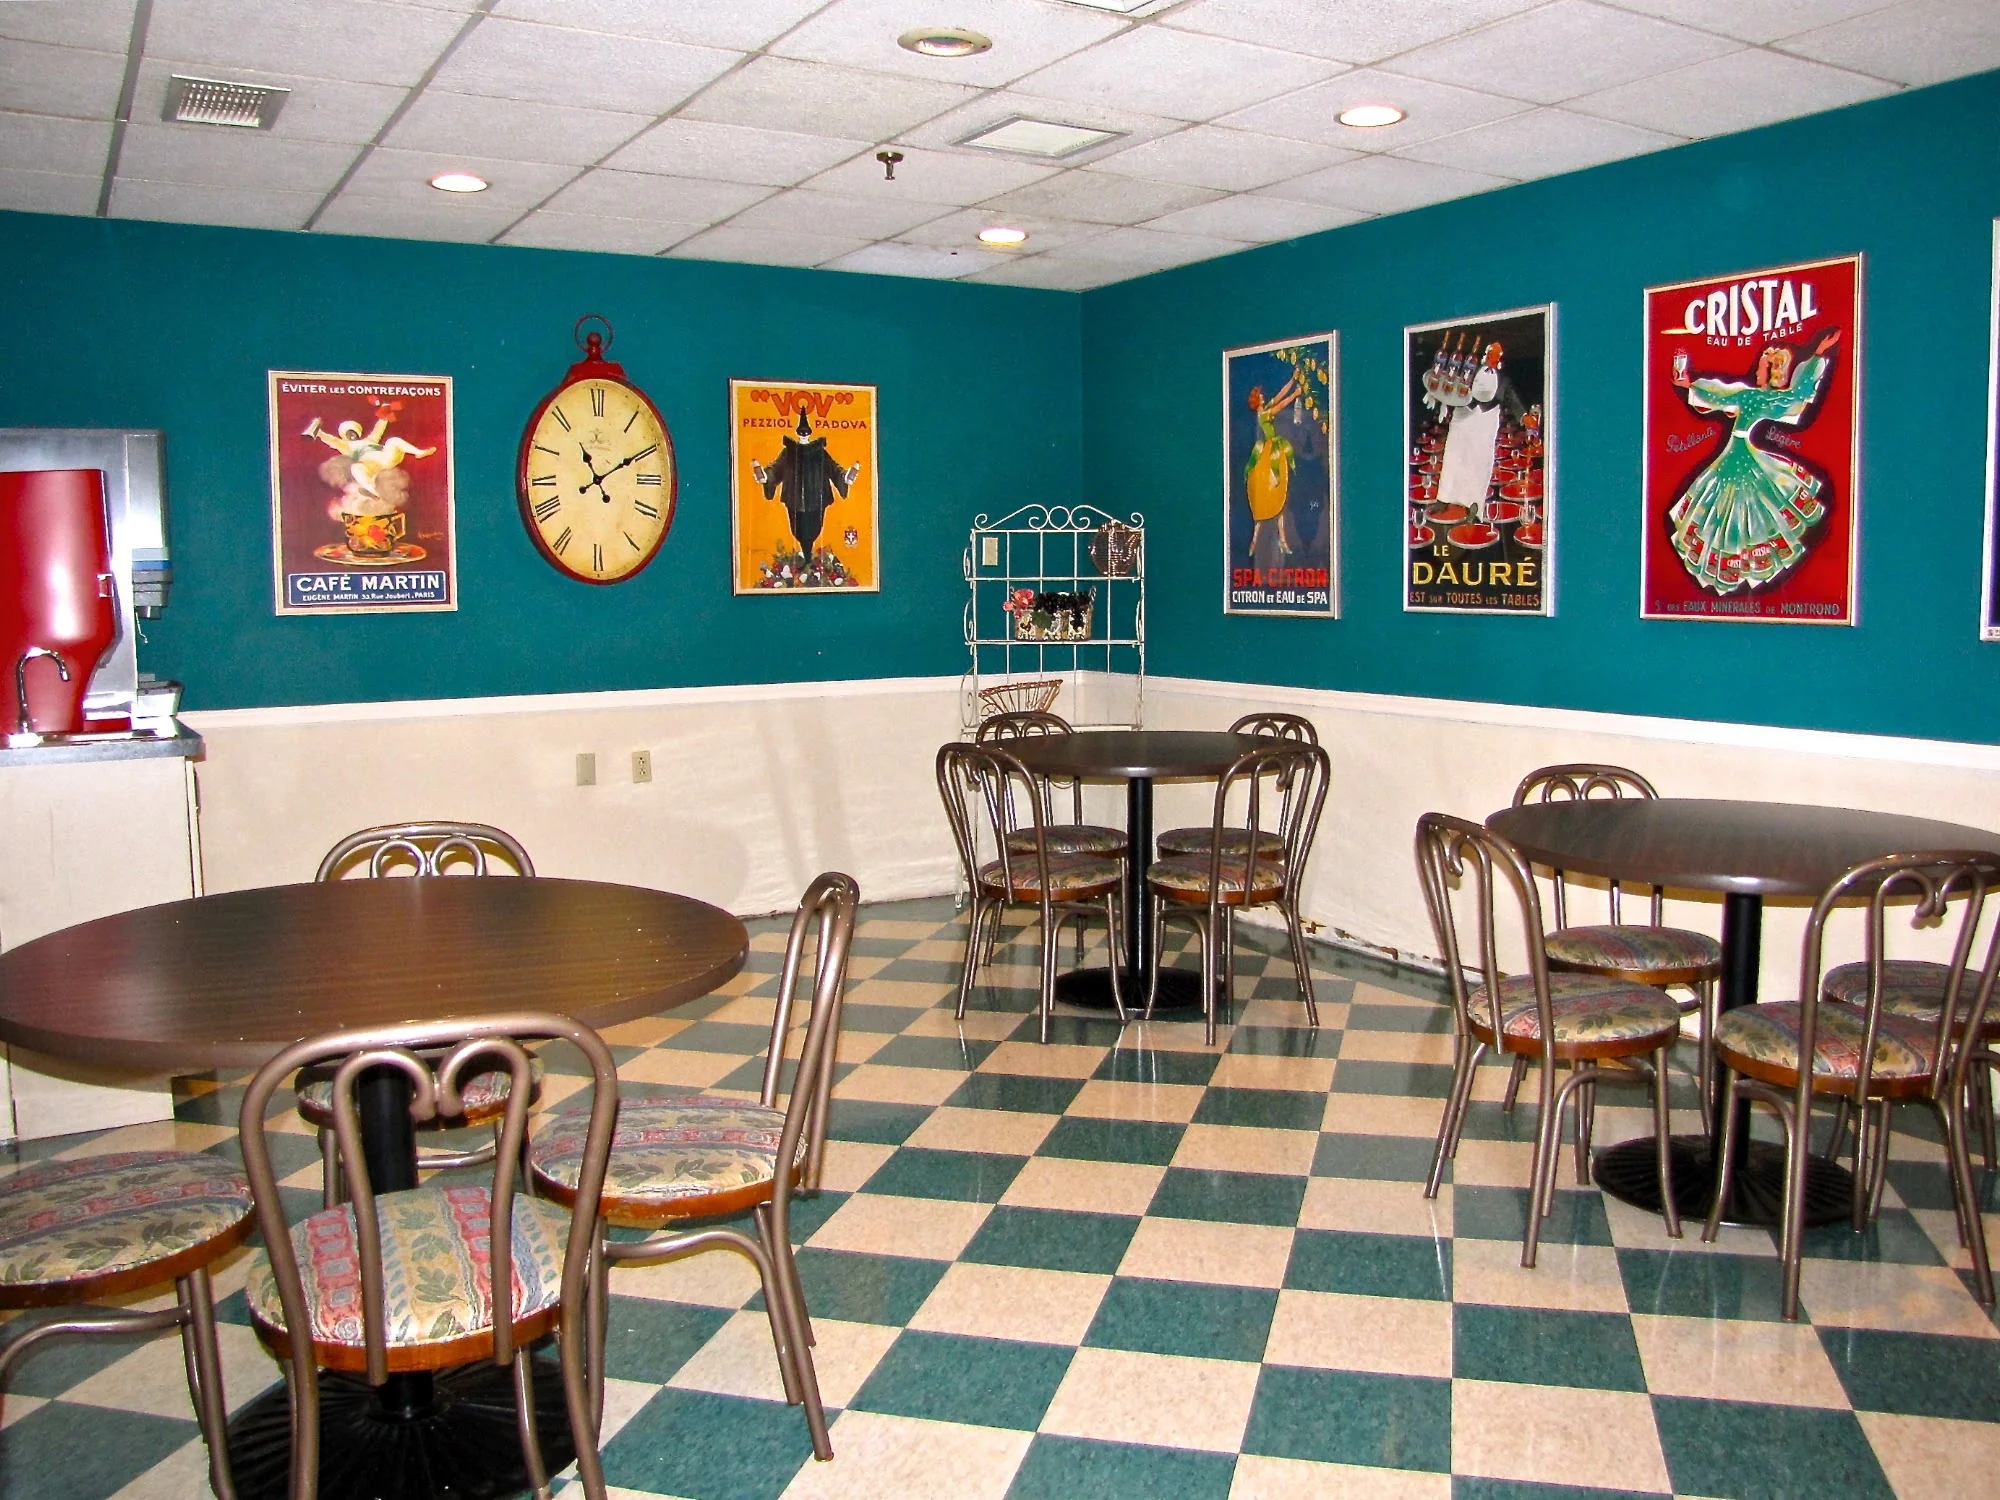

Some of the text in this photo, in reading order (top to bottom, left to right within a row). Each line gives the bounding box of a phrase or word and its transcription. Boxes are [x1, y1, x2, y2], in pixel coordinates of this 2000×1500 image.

[1684, 280, 1817, 336] CRISTAL
[1706, 322, 1803, 347] EAU DE TABLE
[282, 382, 326, 394] ÉVITER
[347, 385, 441, 397] CONTREFAÇONS
[743, 418, 867, 429] PEZZIOL PADOVA
[1433, 545, 1449, 557] LE
[1412, 556, 1538, 587] DAURÉ
[296, 574, 440, 592] CAFÉ MARTIN
[302, 594, 331, 602] EUGÈNE
[414, 591, 435, 599] PARIS
[1232, 590, 1328, 605] CITRON ET EAU DE SPA
[1410, 591, 1426, 603] EST
[1446, 591, 1482, 605] TOUTES
[1501, 593, 1540, 607] TABLES
[1683, 601, 1706, 612] EAUX
[1765, 605, 1775, 614] DE
[1781, 603, 1840, 616] MONTROND
